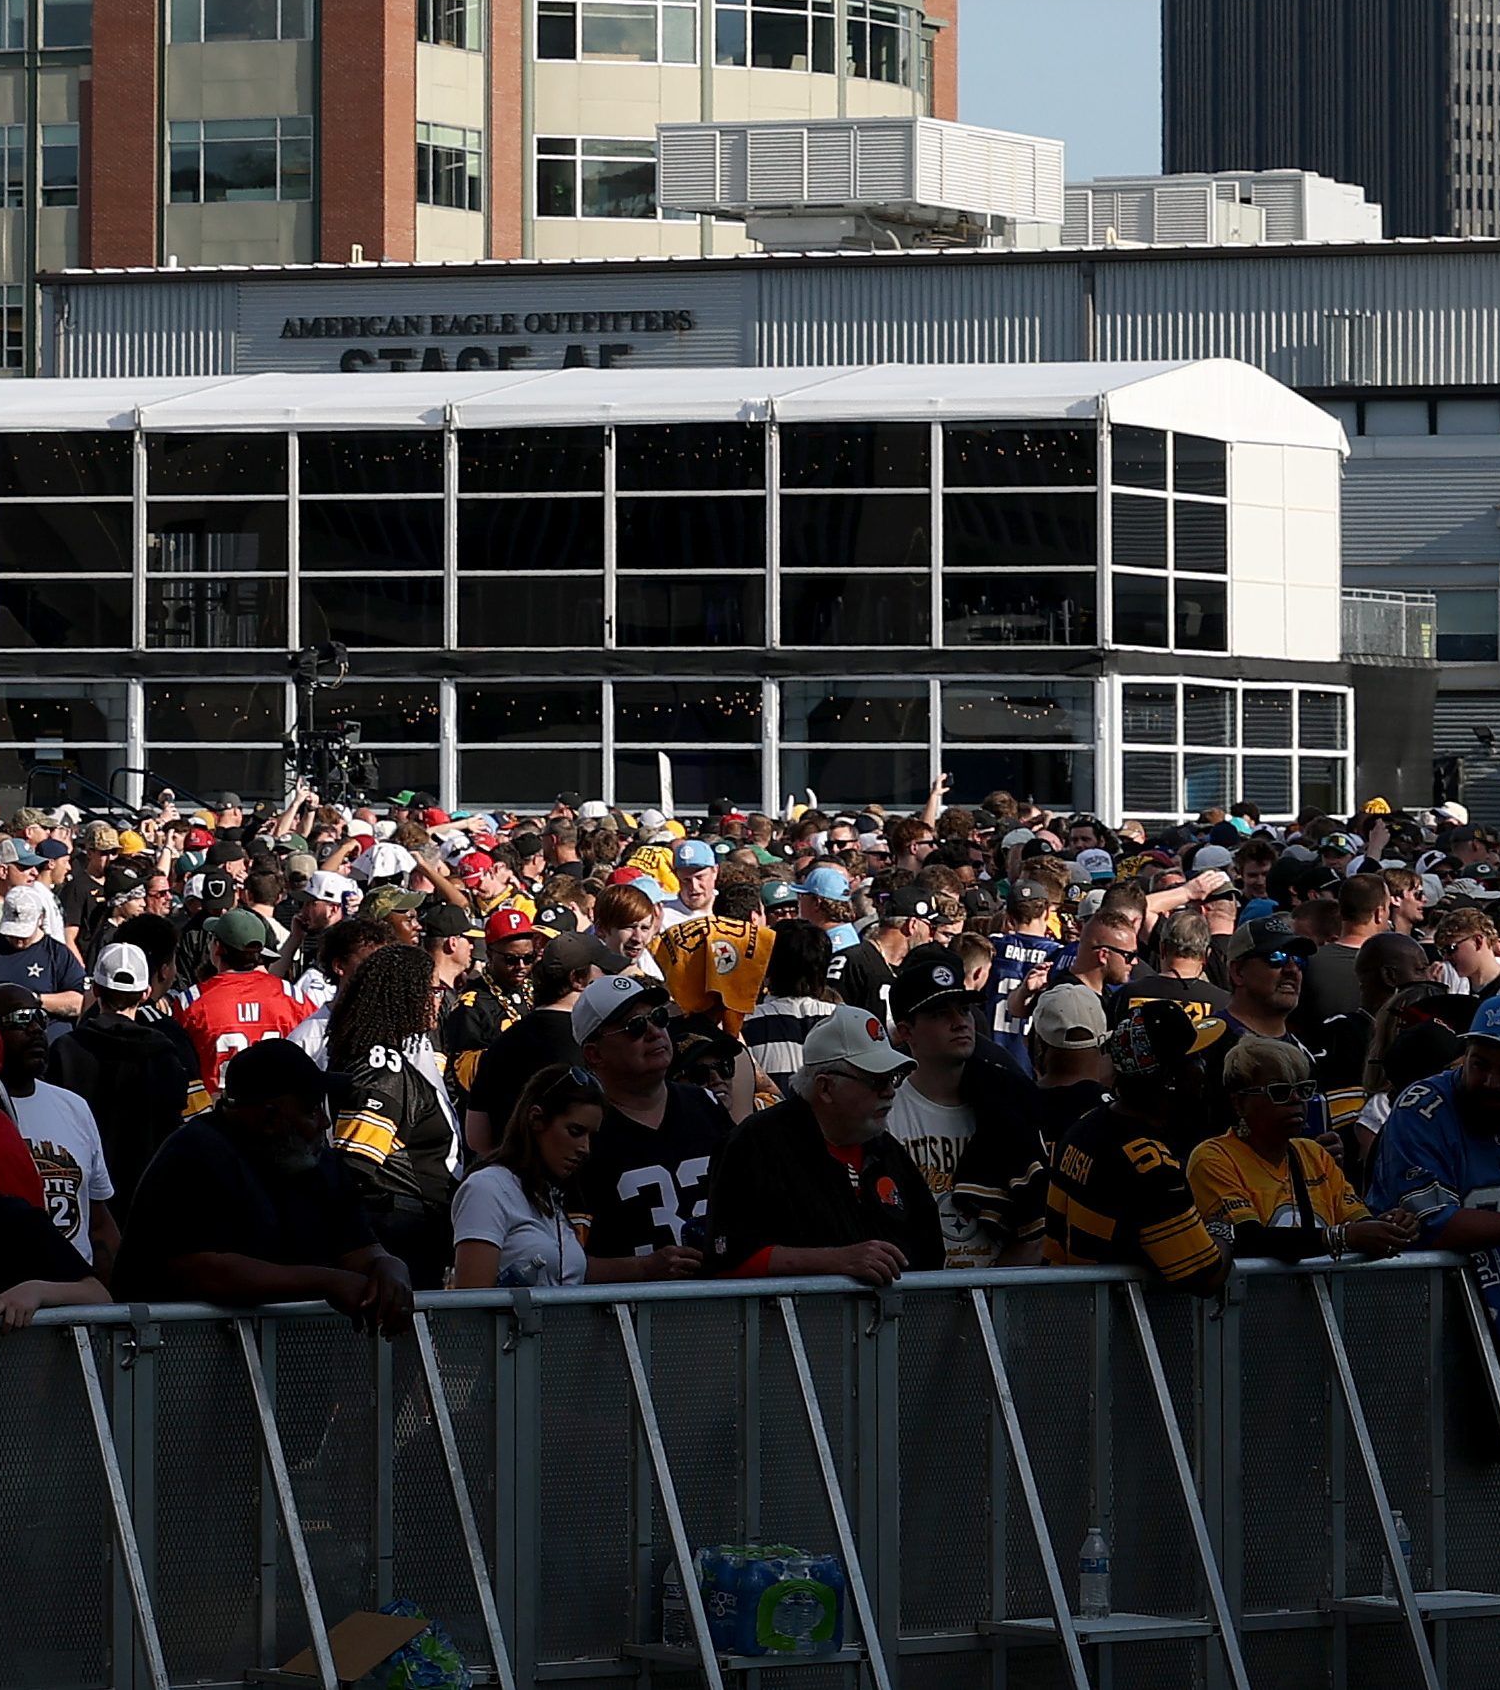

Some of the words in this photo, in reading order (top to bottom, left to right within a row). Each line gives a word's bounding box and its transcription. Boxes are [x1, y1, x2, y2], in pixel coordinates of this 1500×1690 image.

[279, 315, 423, 340] AMERICAN
[430, 312, 517, 337] EAGLE
[524, 308, 695, 334] OUTFITTERS
[508, 913, 520, 930] P
[368, 1044, 401, 1073] 83
[1059, 1143, 1094, 1187] BUSH
